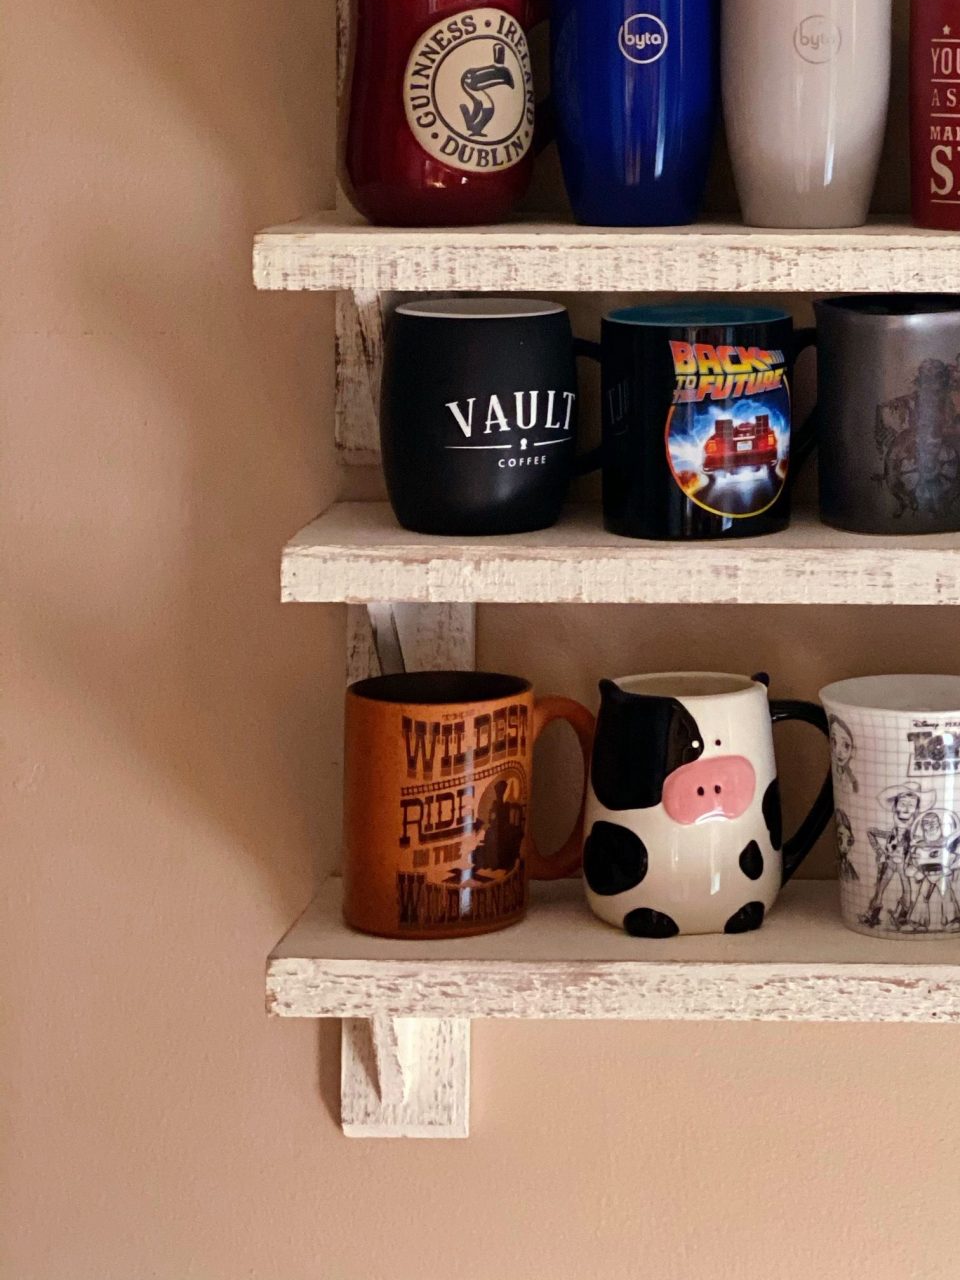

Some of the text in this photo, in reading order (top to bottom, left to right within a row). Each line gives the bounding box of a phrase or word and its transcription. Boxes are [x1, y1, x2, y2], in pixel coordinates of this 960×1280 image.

[625, 23, 662, 49] byta
[410, 14, 535, 128] GUINNESS IRELAND
[931, 89, 941, 106] A
[439, 134, 524, 168] DUBLIN
[669, 340, 785, 376] BACK
[675, 375, 697, 390] TO
[697, 368, 784, 402] FUTURE
[445, 390, 575, 438] VAULT
[498, 455, 546, 468] COFFEE
[402, 703, 528, 778] WILDEST
[914, 760, 960, 771] STORY
[399, 785, 482, 846] RIDE
